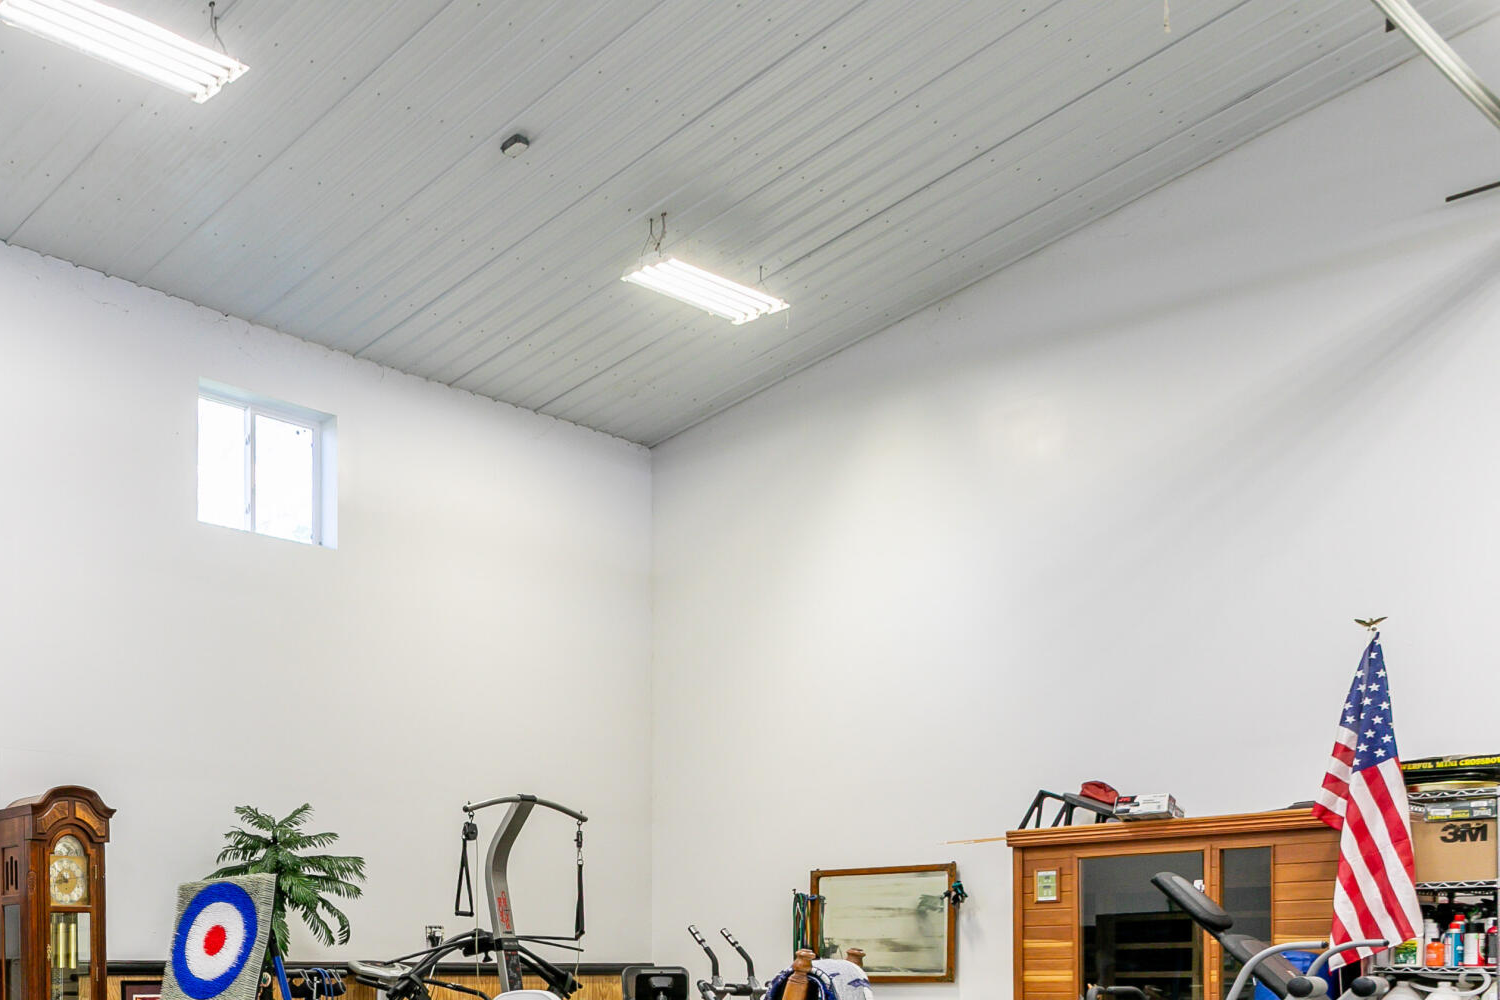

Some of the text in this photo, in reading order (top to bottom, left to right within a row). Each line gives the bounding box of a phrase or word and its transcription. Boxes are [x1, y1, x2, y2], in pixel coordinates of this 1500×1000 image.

[1435, 760, 1457, 768] MINI
[1459, 756, 1500, 766] CROSSBO
[1440, 823, 1488, 843] 3M
